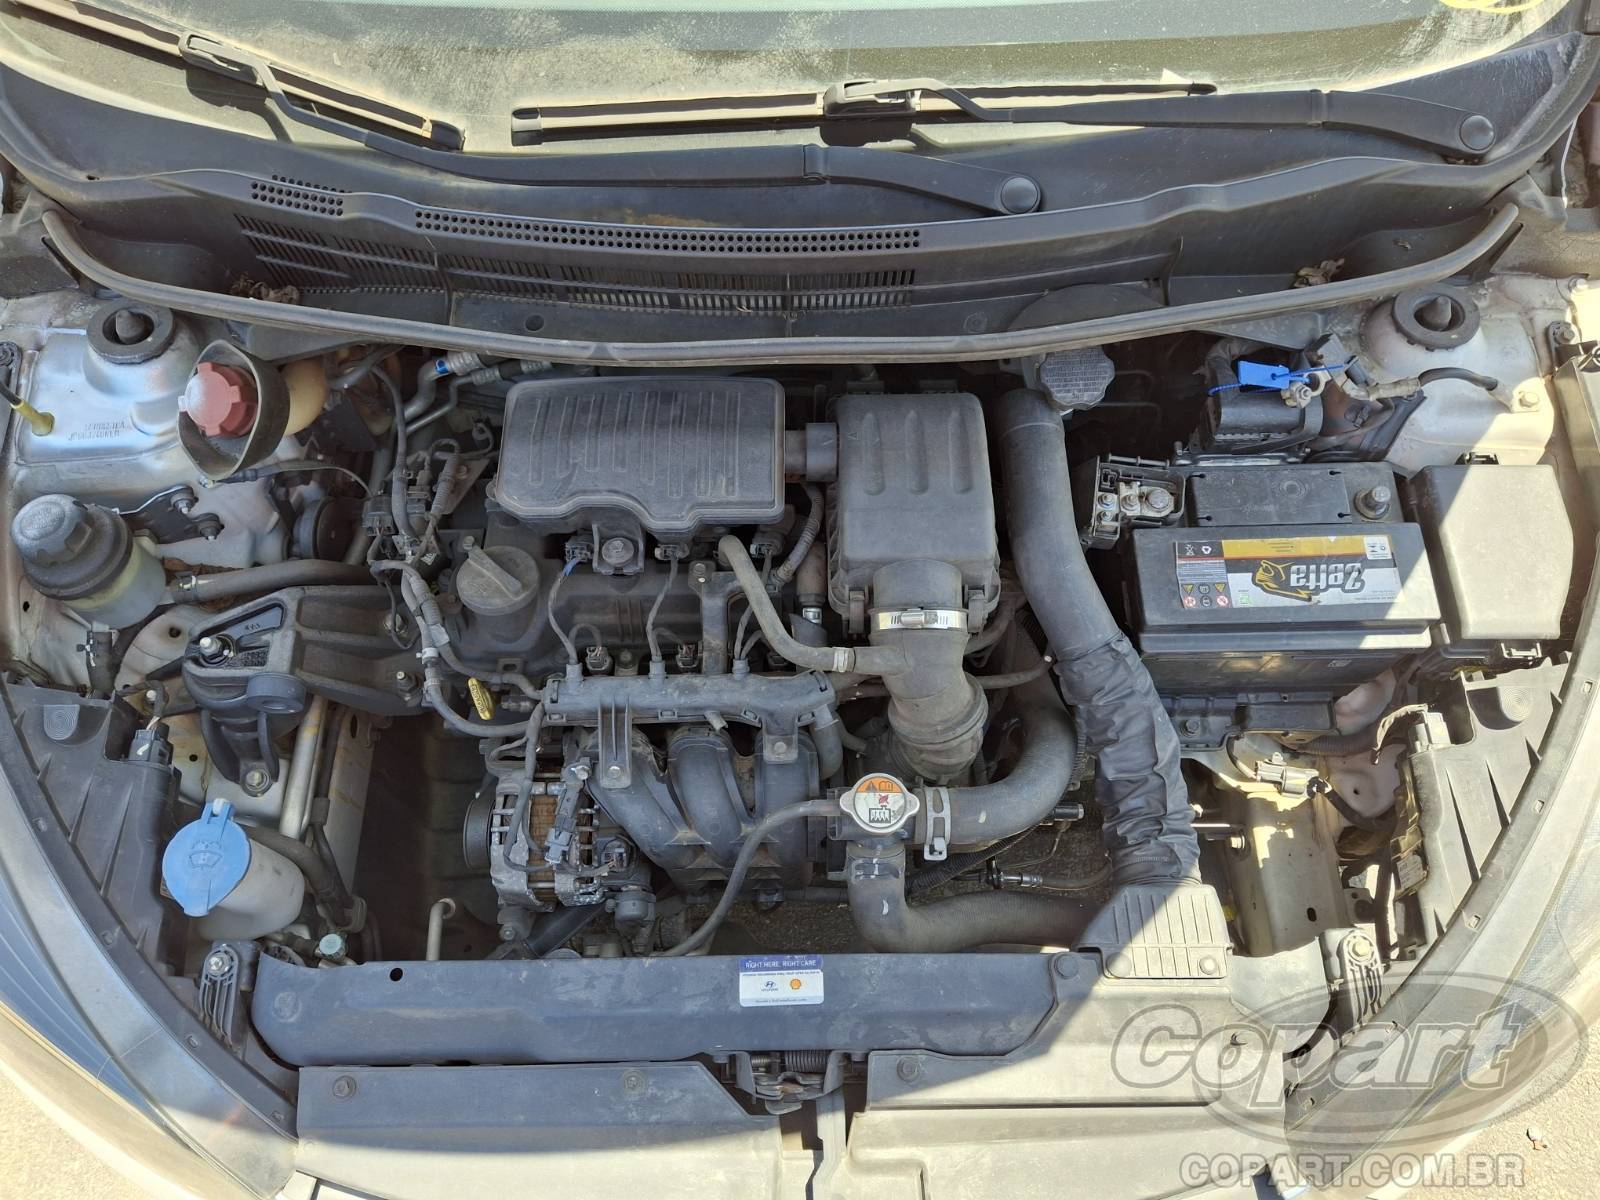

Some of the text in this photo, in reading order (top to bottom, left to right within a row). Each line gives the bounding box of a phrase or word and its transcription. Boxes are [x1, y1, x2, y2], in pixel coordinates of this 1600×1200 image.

[1290, 562, 1362, 590] Zetta
[745, 961, 762, 969] RIGHT
[800, 959, 817, 967] CARE
